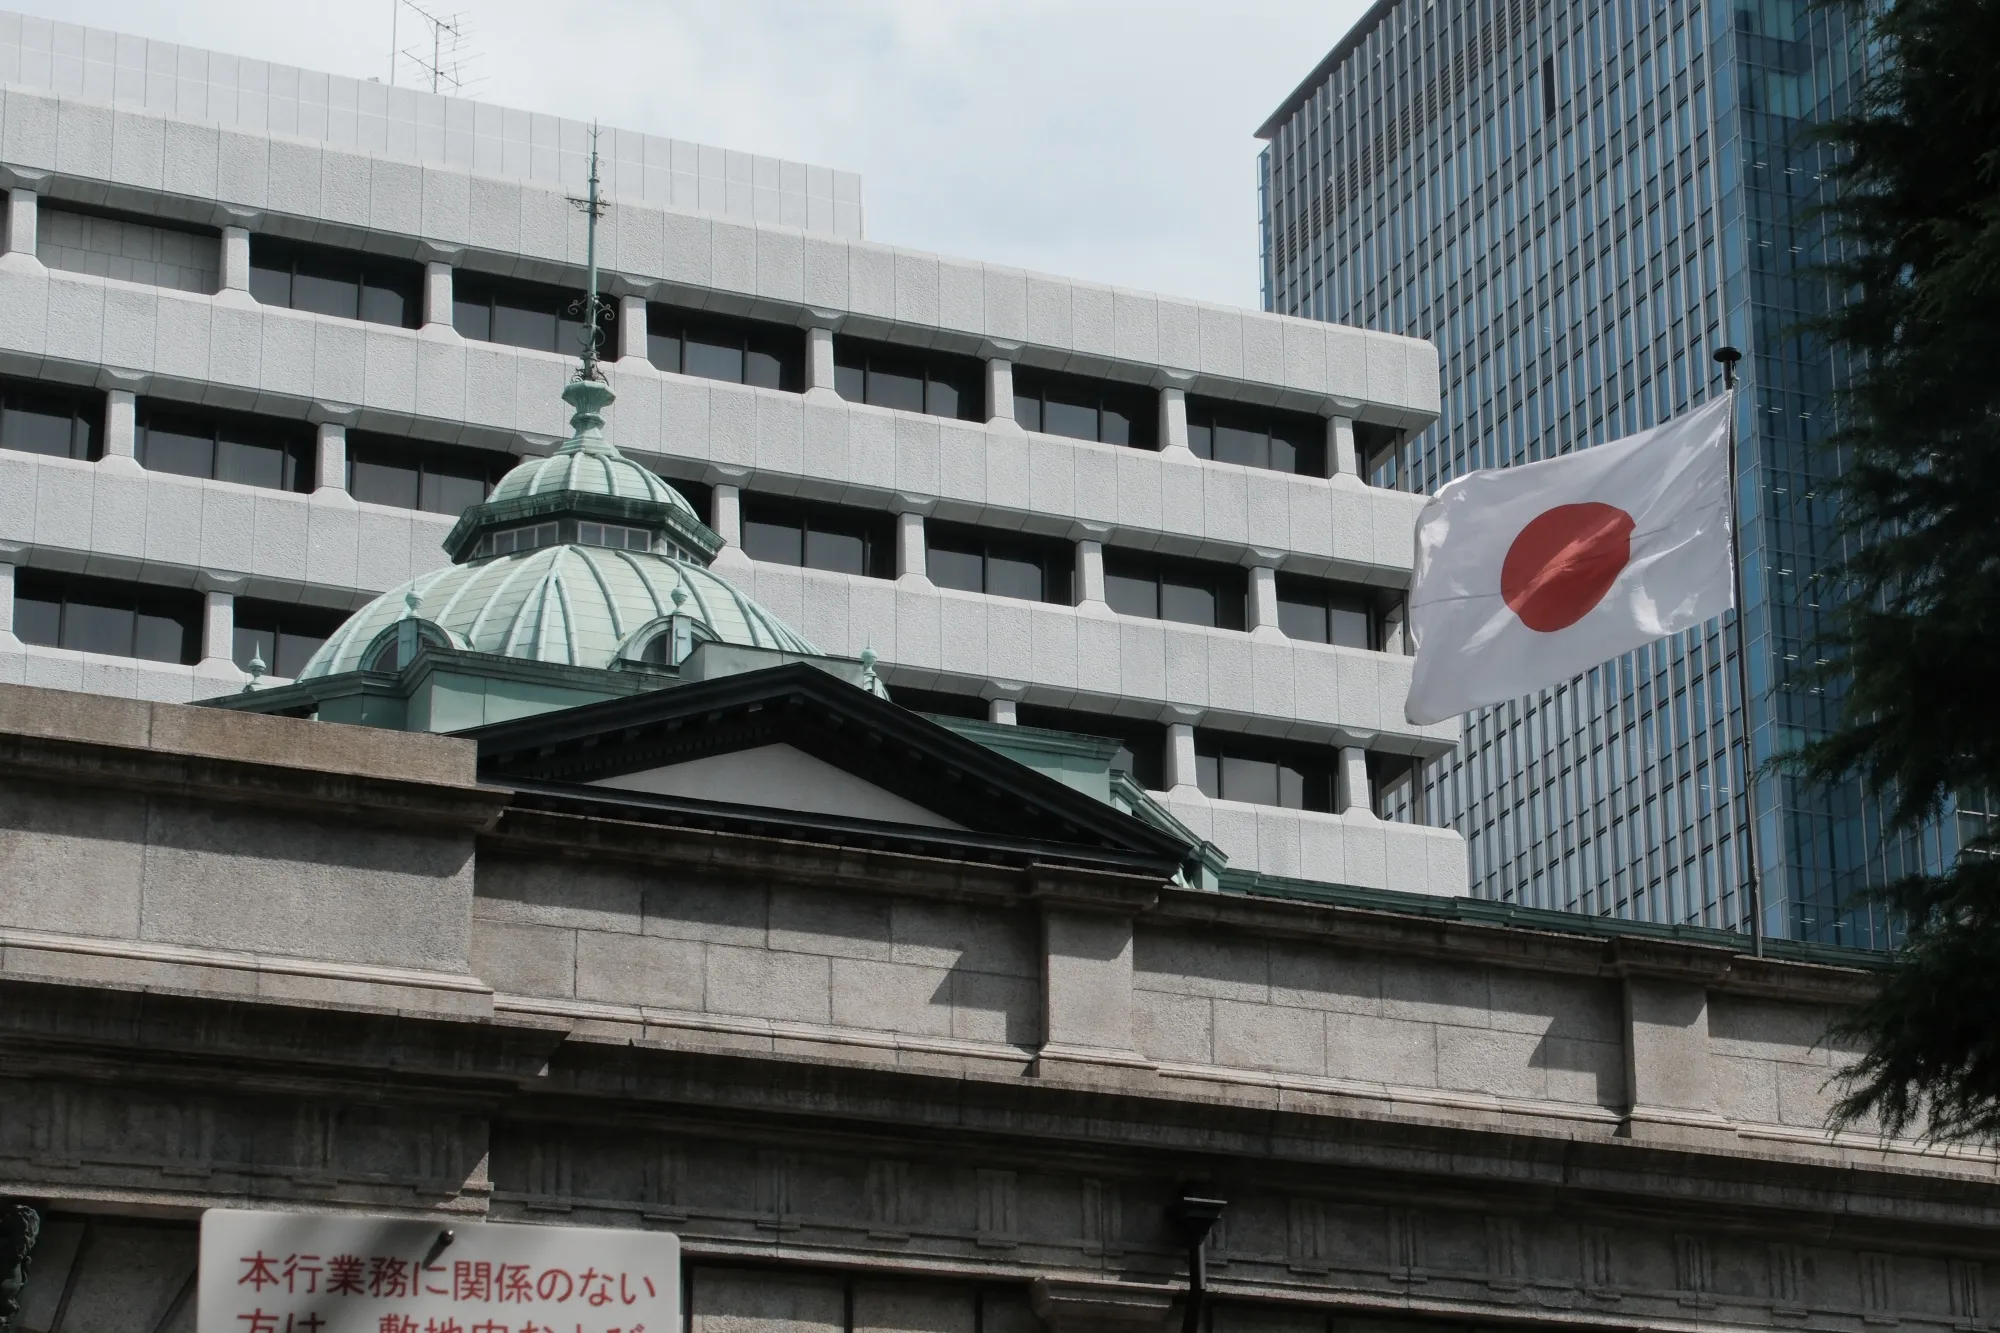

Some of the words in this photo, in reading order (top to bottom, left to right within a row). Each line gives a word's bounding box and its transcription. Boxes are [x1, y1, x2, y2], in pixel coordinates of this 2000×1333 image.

[237, 1251, 657, 1307] 本行業務に関係のない
